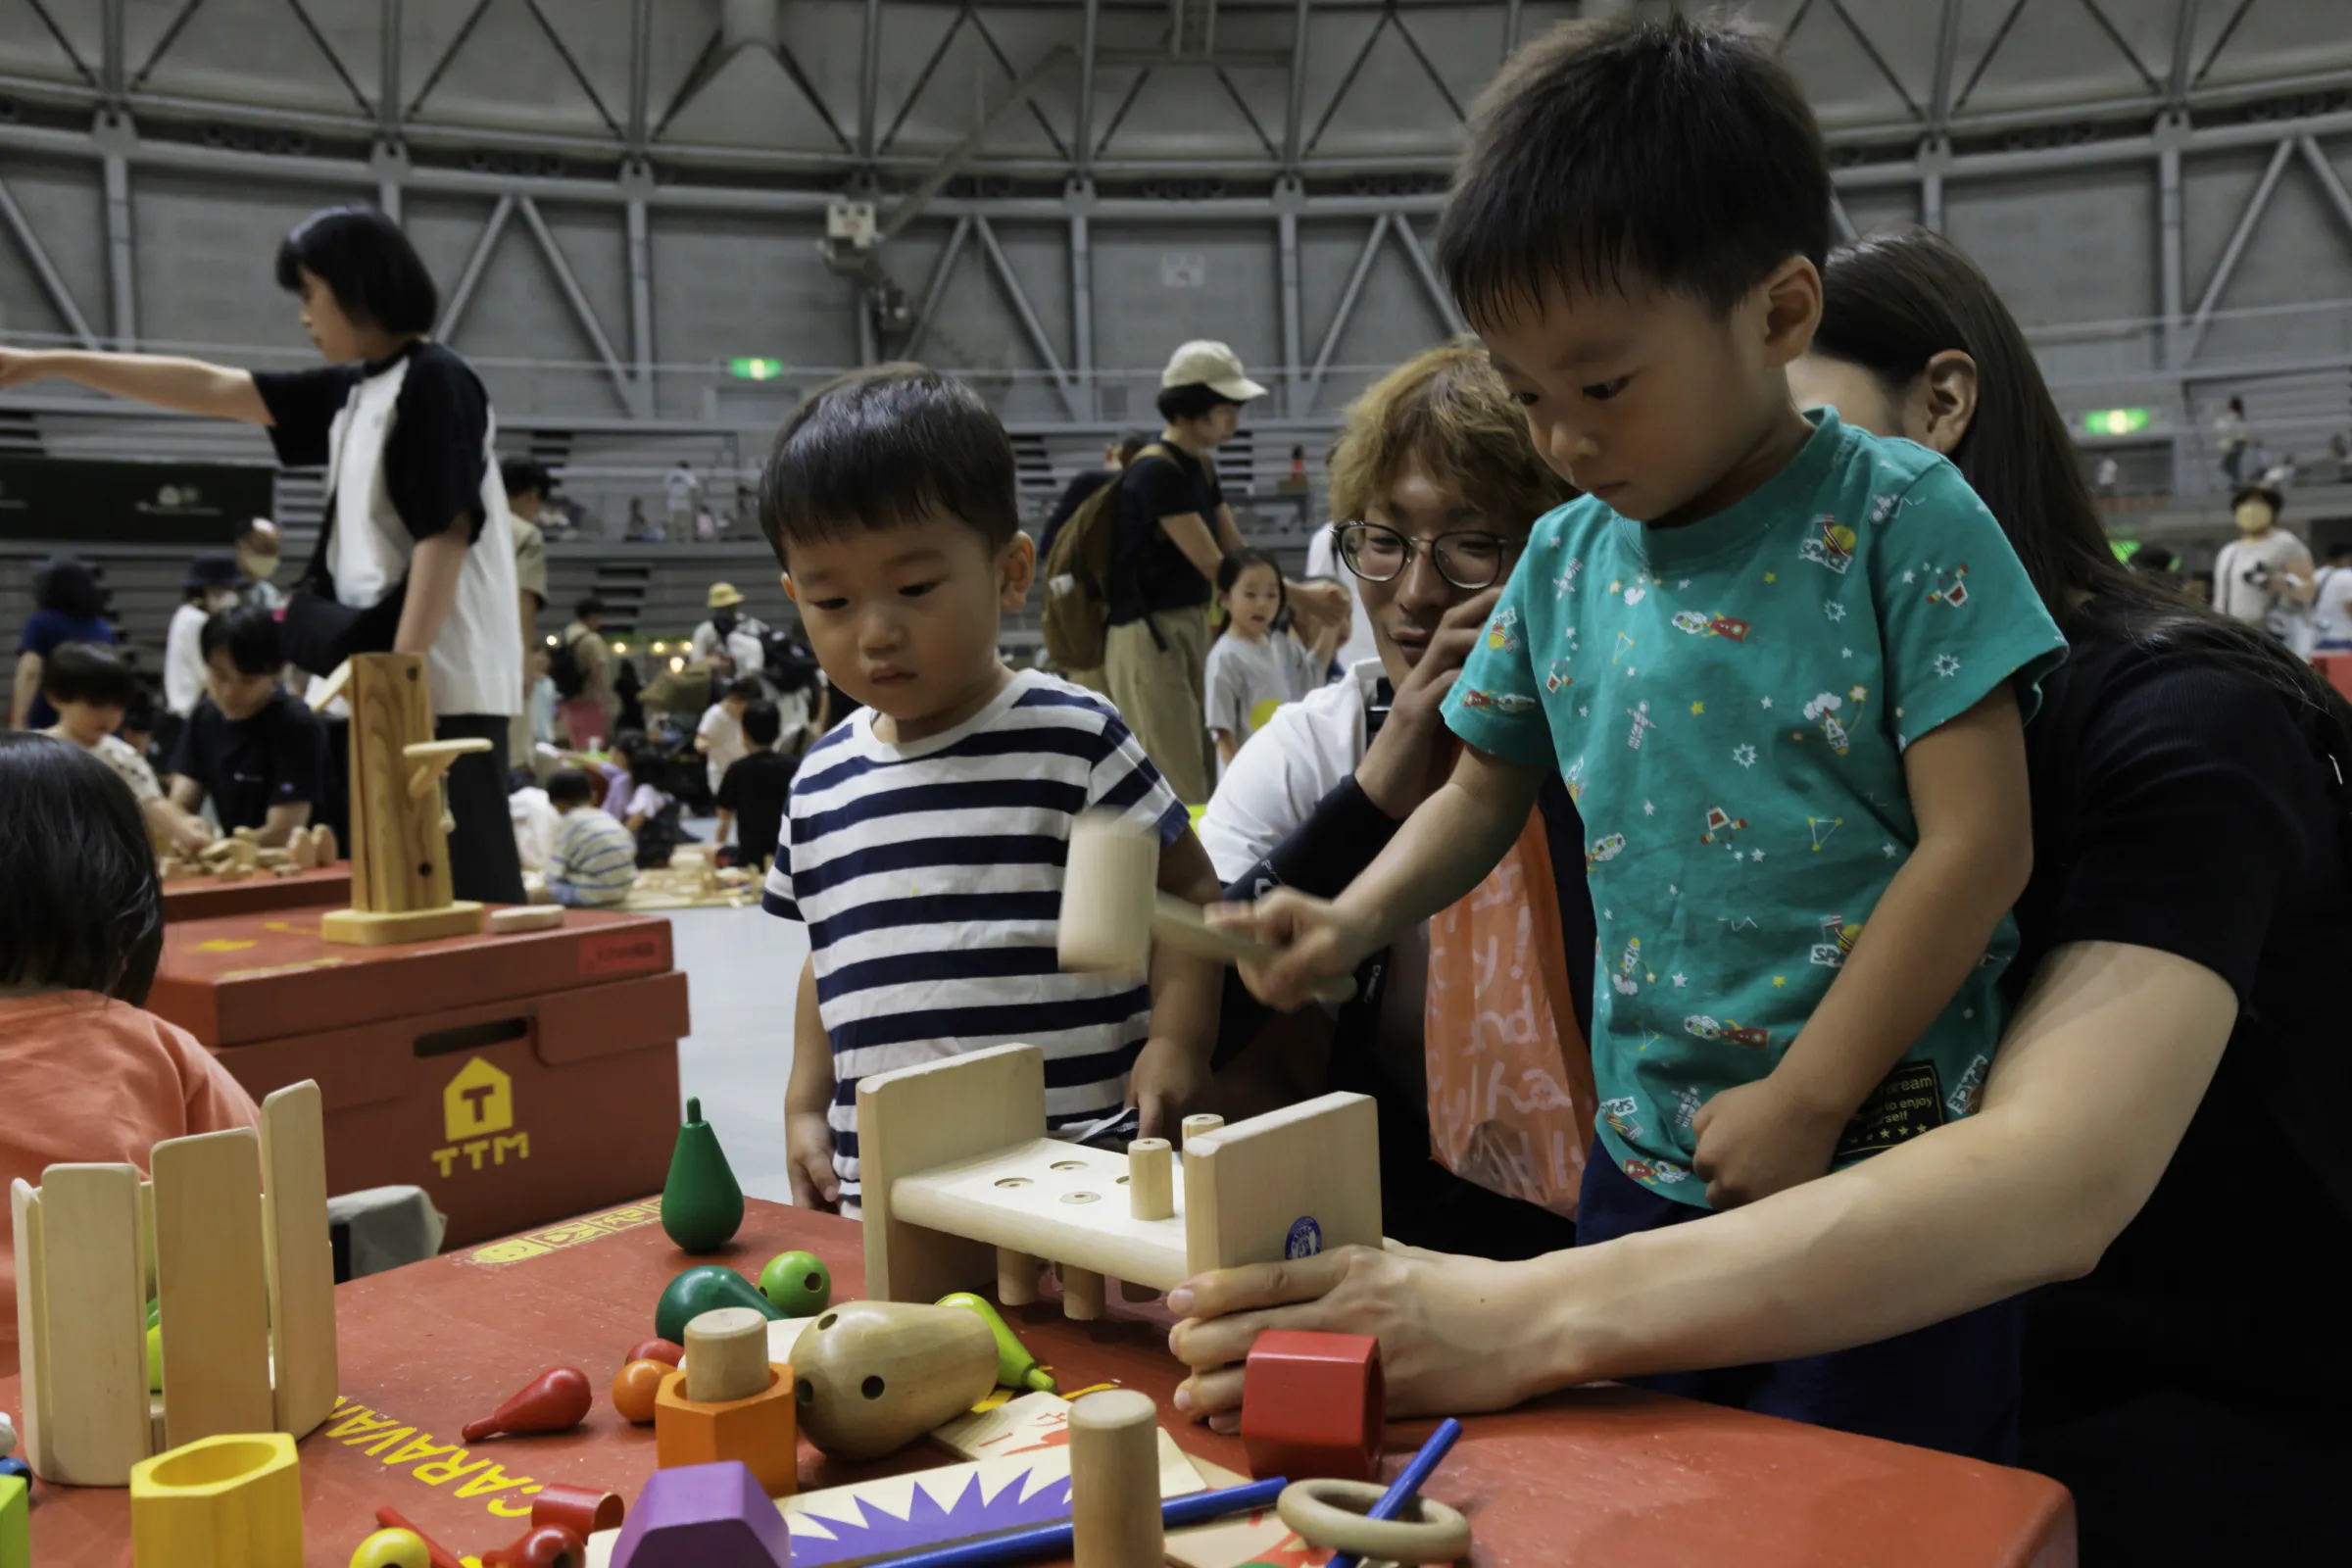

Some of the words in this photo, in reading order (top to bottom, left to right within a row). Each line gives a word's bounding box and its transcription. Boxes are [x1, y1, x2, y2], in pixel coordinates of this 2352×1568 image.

[460, 1083, 494, 1124] T
[1899, 1097, 1934, 1109] enjoy
[431, 1131, 528, 1178] TTM
